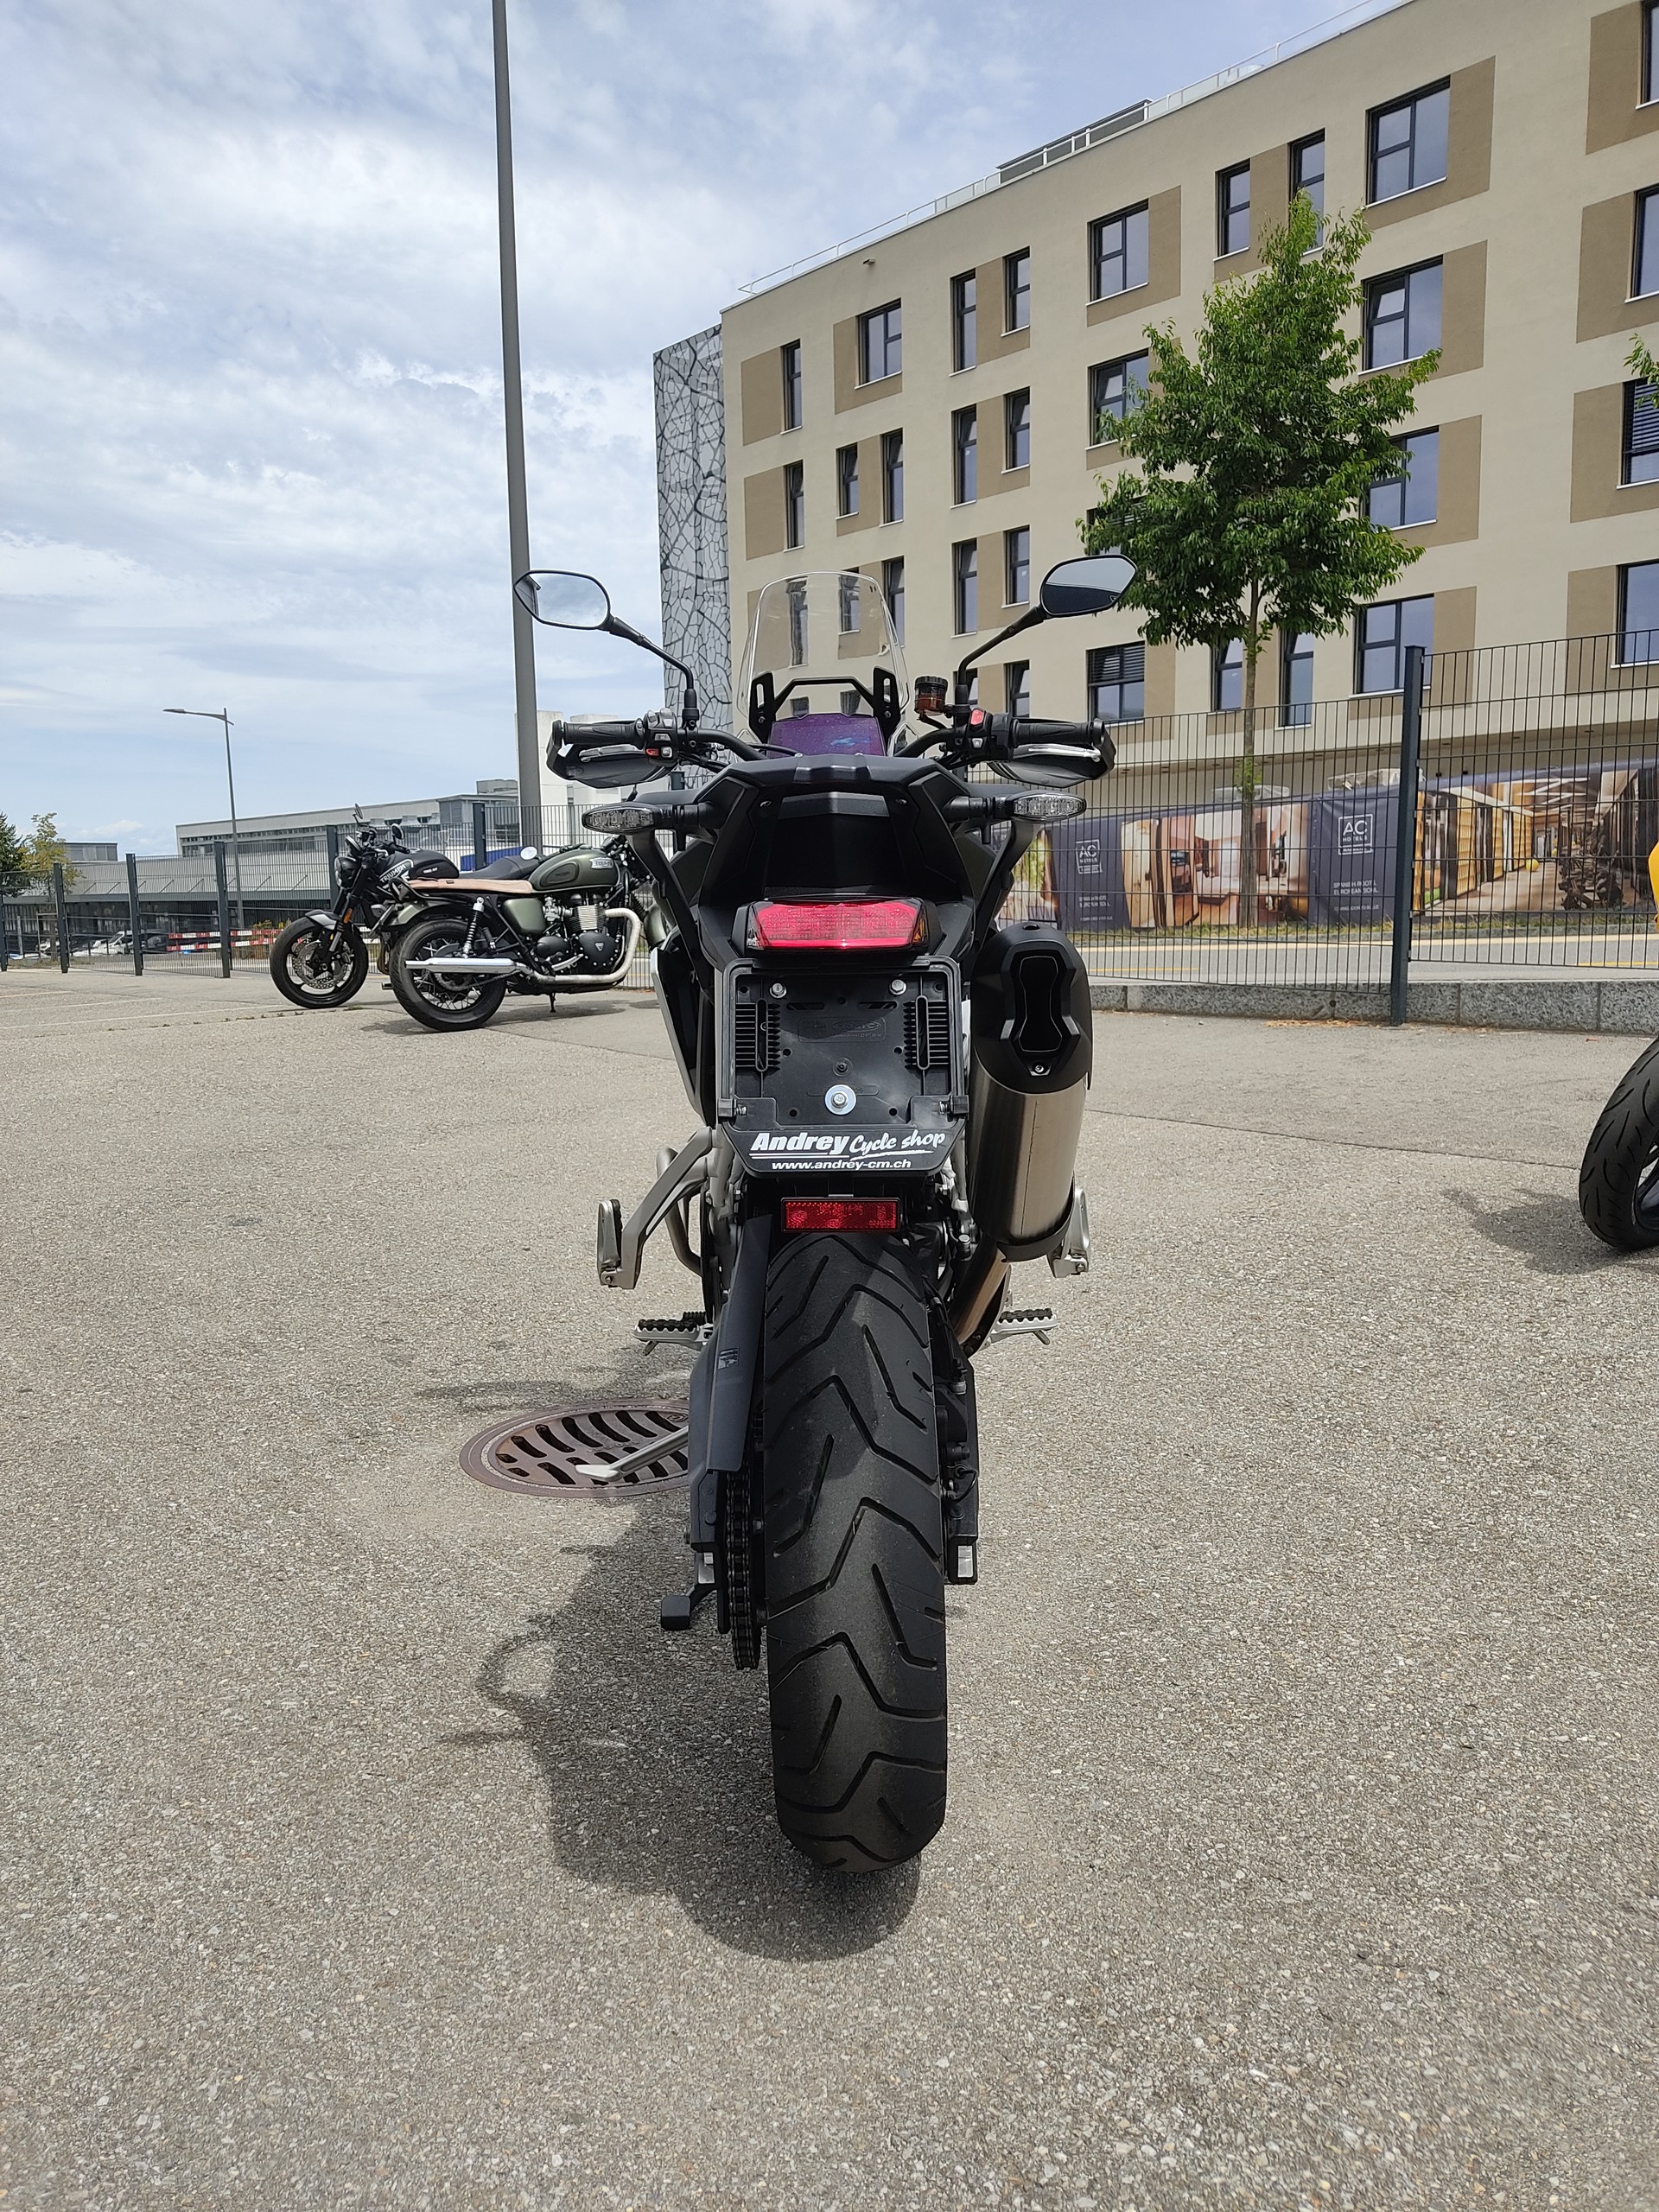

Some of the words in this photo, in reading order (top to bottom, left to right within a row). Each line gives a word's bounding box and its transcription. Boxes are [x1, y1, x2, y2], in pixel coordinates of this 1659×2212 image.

[1343, 819, 1368, 836] AC
[1079, 844, 1097, 858] AC
[380, 864, 406, 883] TRIUMPH
[750, 1132, 850, 1155] Andrey
[849, 1133, 897, 1156] Cycle
[901, 1129, 945, 1148] shop
[772, 1159, 912, 1171] www.andrey-cm.ch
